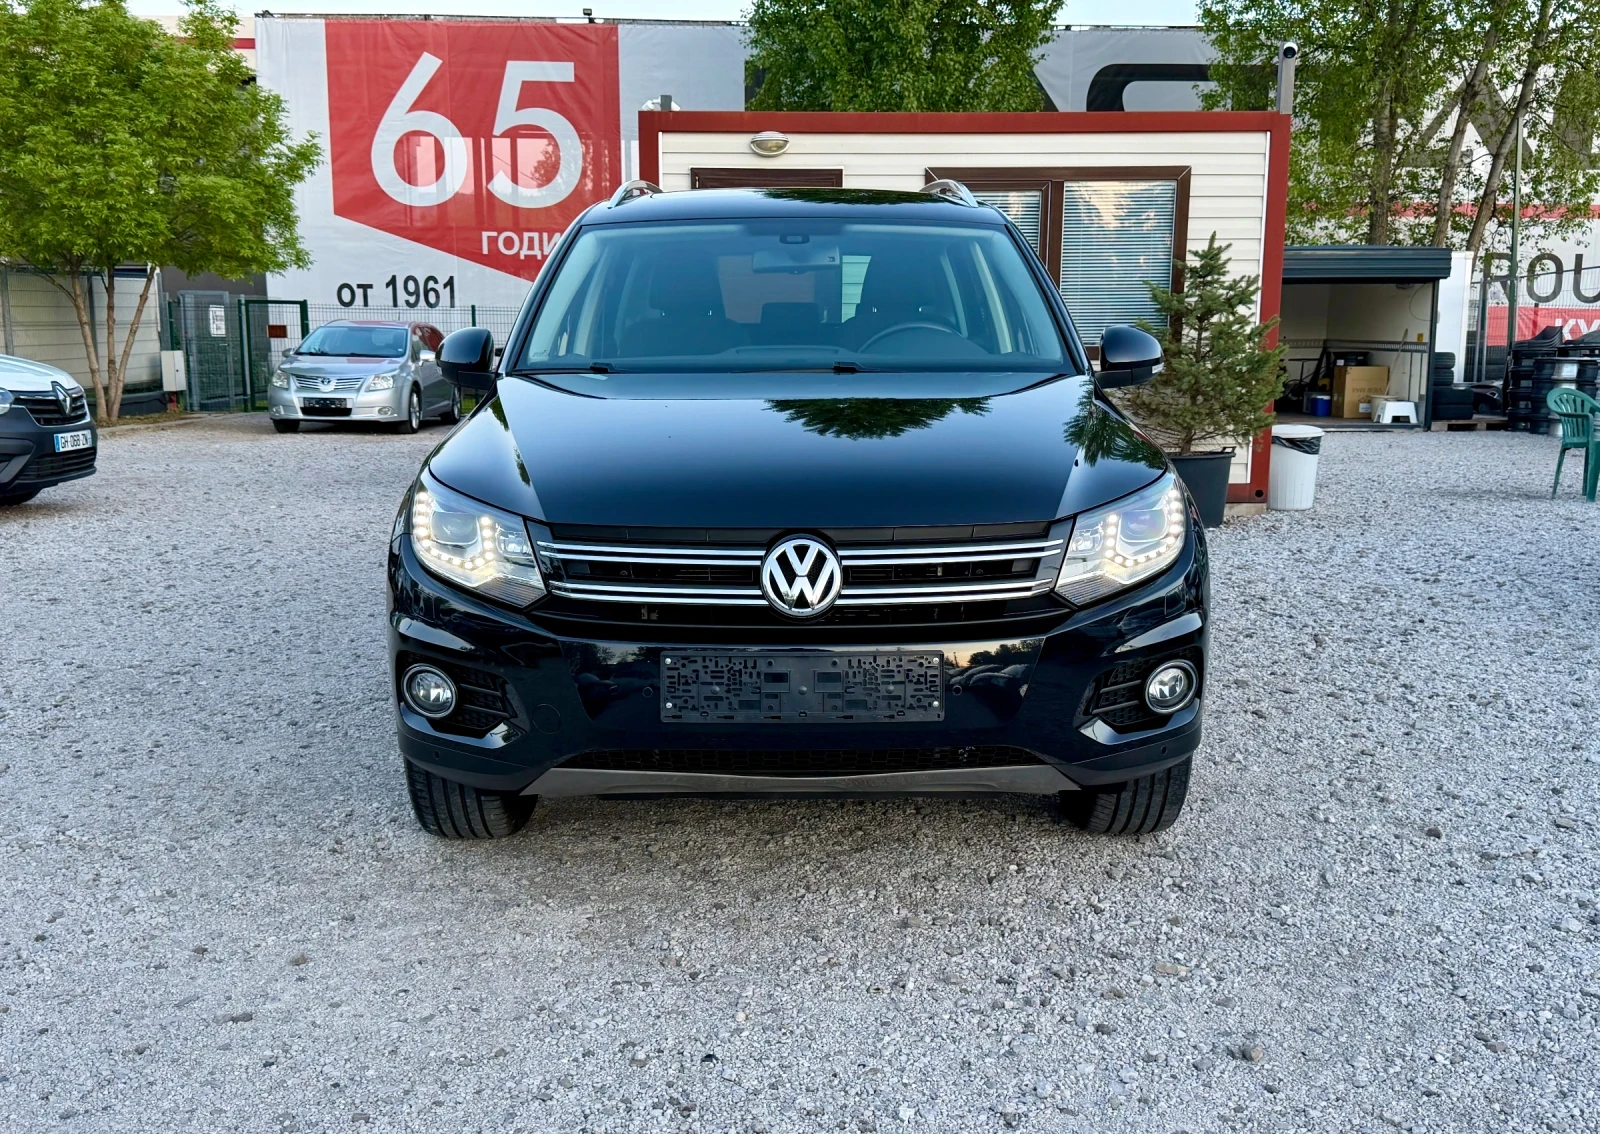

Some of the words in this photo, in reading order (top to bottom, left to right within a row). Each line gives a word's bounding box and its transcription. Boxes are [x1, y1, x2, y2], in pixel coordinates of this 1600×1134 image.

[371, 51, 583, 209] 65
[336, 282, 374, 308] от
[385, 274, 456, 309] 1961
